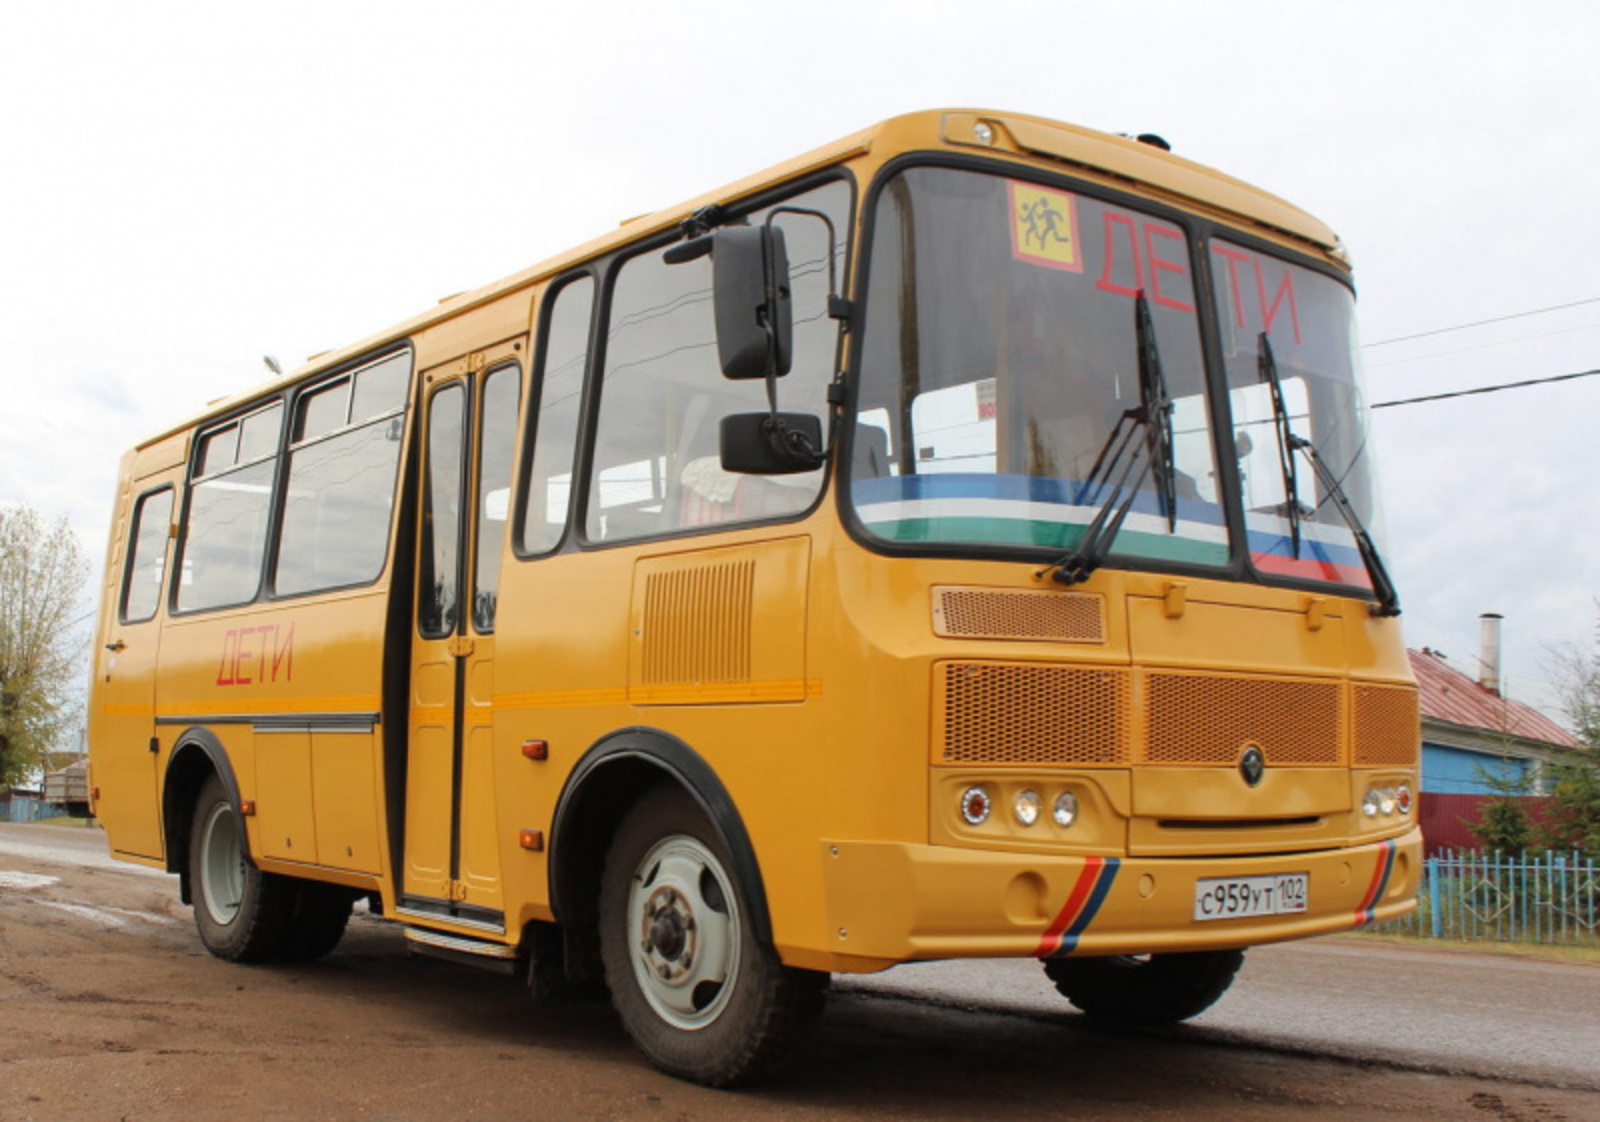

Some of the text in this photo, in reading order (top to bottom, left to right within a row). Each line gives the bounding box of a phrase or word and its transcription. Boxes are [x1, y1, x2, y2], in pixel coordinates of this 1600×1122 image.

[1095, 210, 1302, 345] ДЕТИ
[216, 622, 296, 686] ДЕТИ
[1278, 878, 1304, 900] 102
